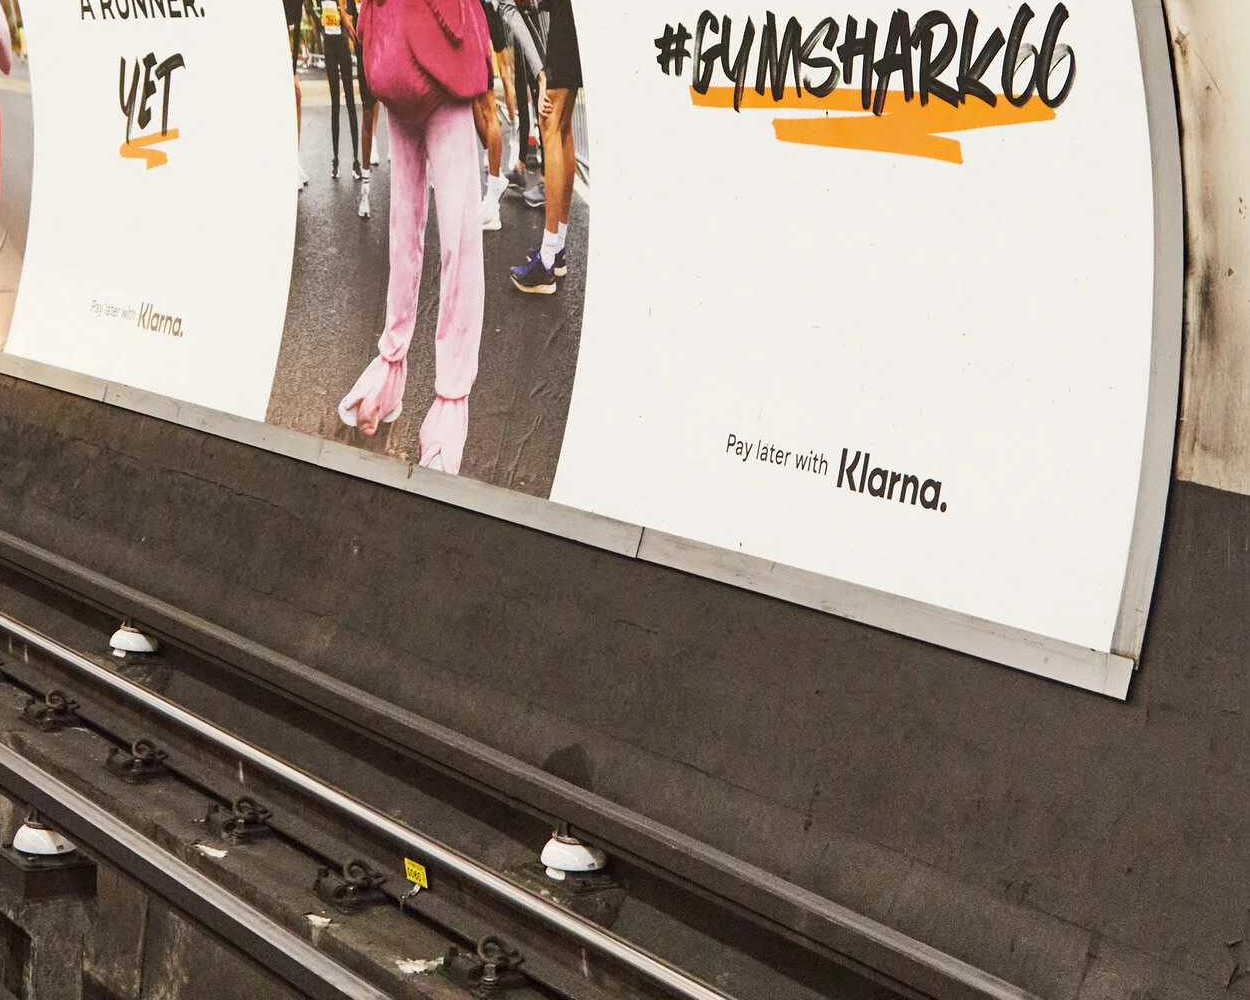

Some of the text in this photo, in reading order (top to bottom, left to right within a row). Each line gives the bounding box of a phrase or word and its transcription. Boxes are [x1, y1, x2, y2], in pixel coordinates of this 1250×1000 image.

[119, 52, 186, 144] YET
[654, 2, 1076, 116] #GYMSHARK66
[90, 299, 103, 317] Pay
[104, 302, 121, 318] later
[136, 302, 183, 338] Klarna.
[726, 433, 948, 513] Pay later with Klarna.
